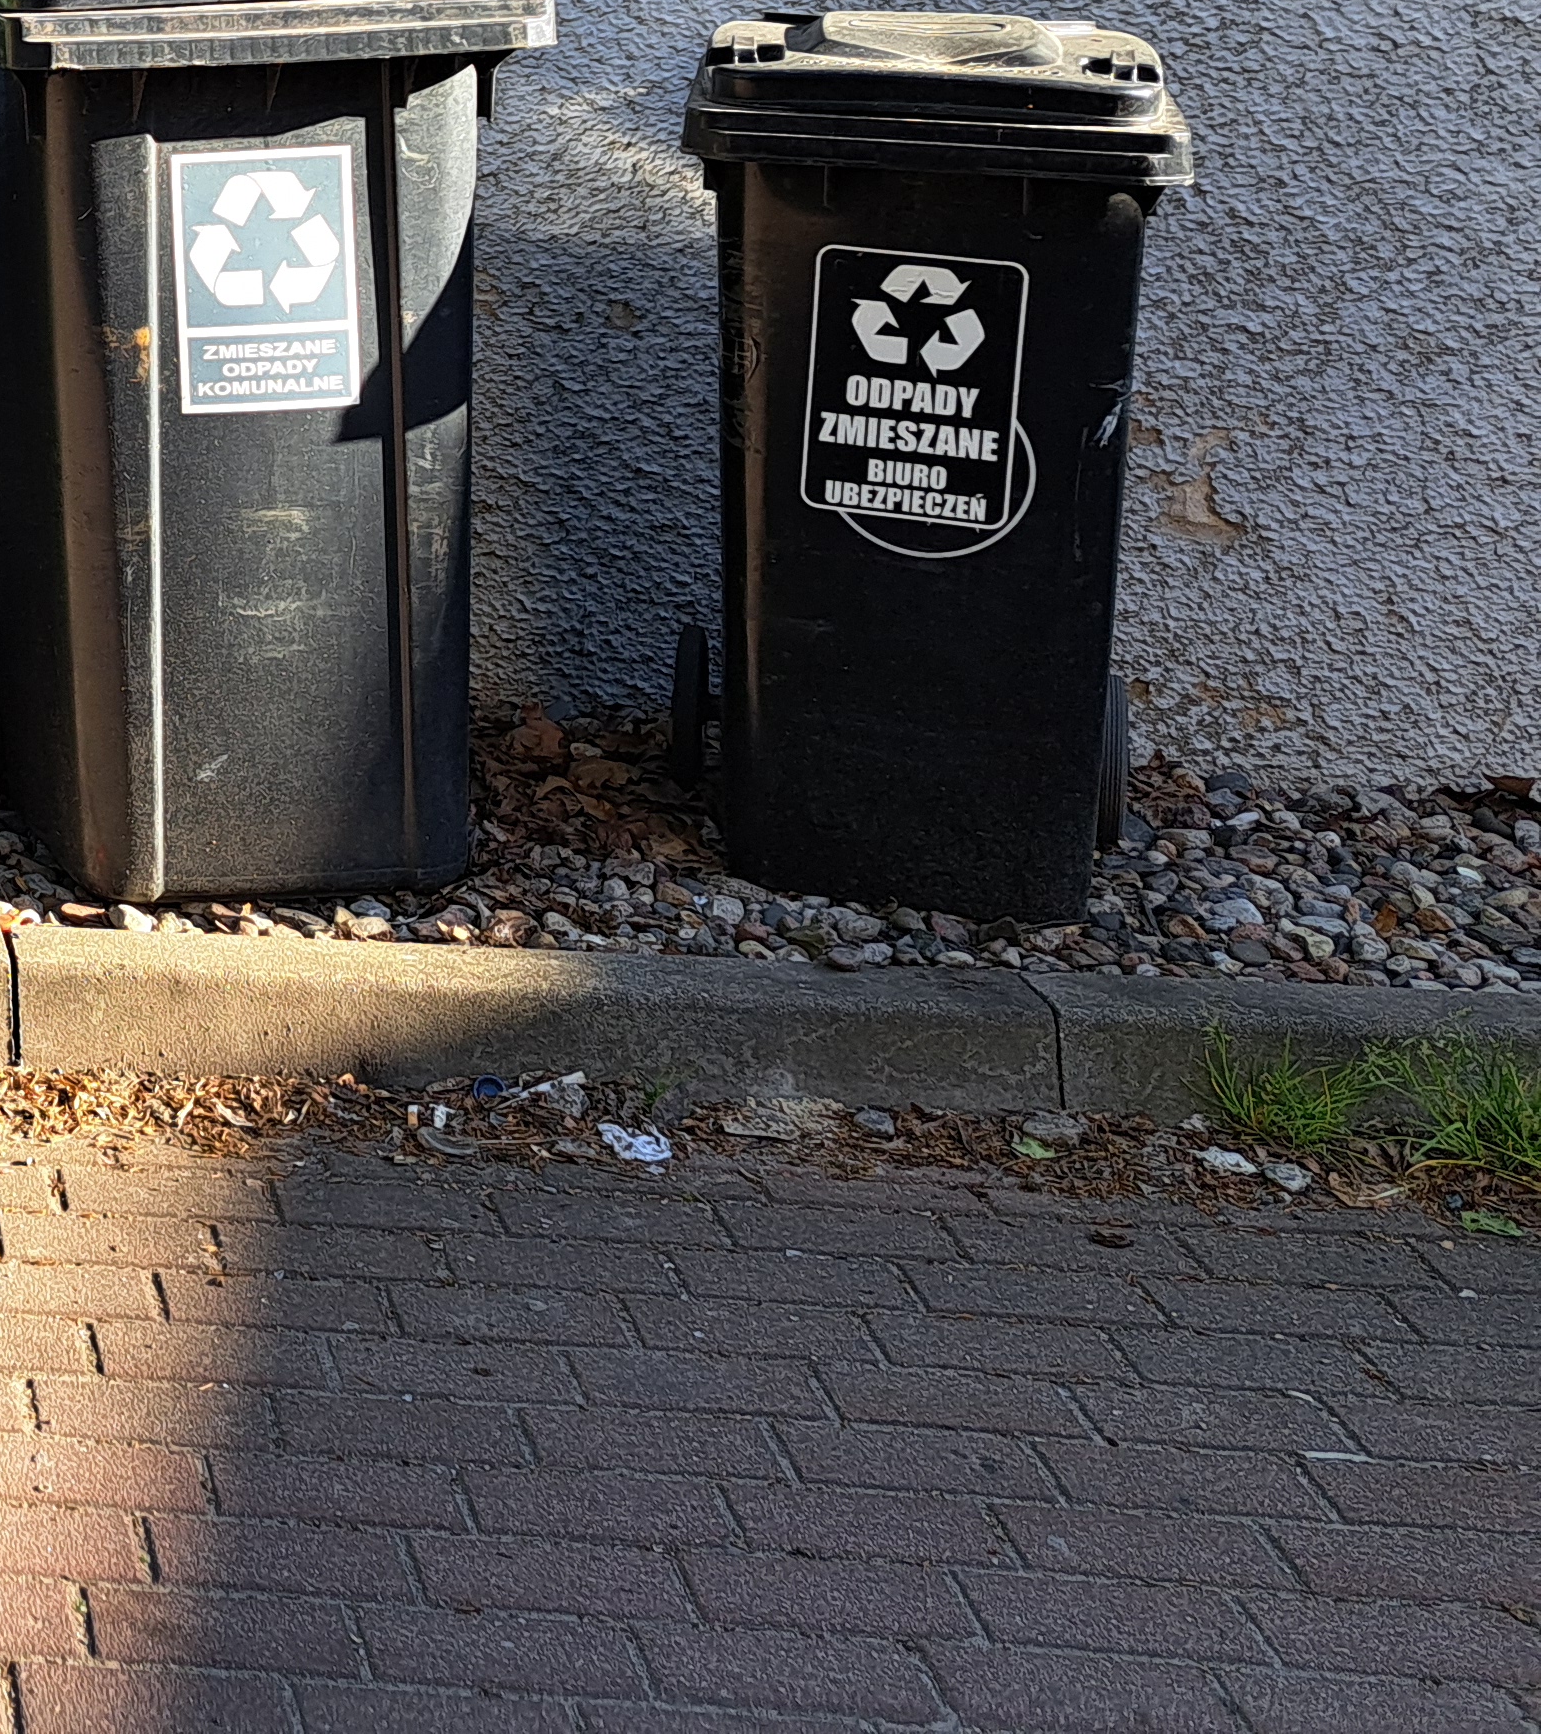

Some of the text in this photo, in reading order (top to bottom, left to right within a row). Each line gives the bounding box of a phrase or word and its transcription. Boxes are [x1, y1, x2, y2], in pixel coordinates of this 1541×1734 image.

[202, 338, 337, 361] ZMIESZANE
[222, 358, 319, 378] ODPADY
[197, 375, 345, 397] KOMUNALNE
[846, 374, 981, 419] ODPADY
[818, 410, 1000, 462] ZMIESZANE
[867, 458, 948, 490] BIURO
[824, 479, 987, 522] UBEZPIECZEŃ
